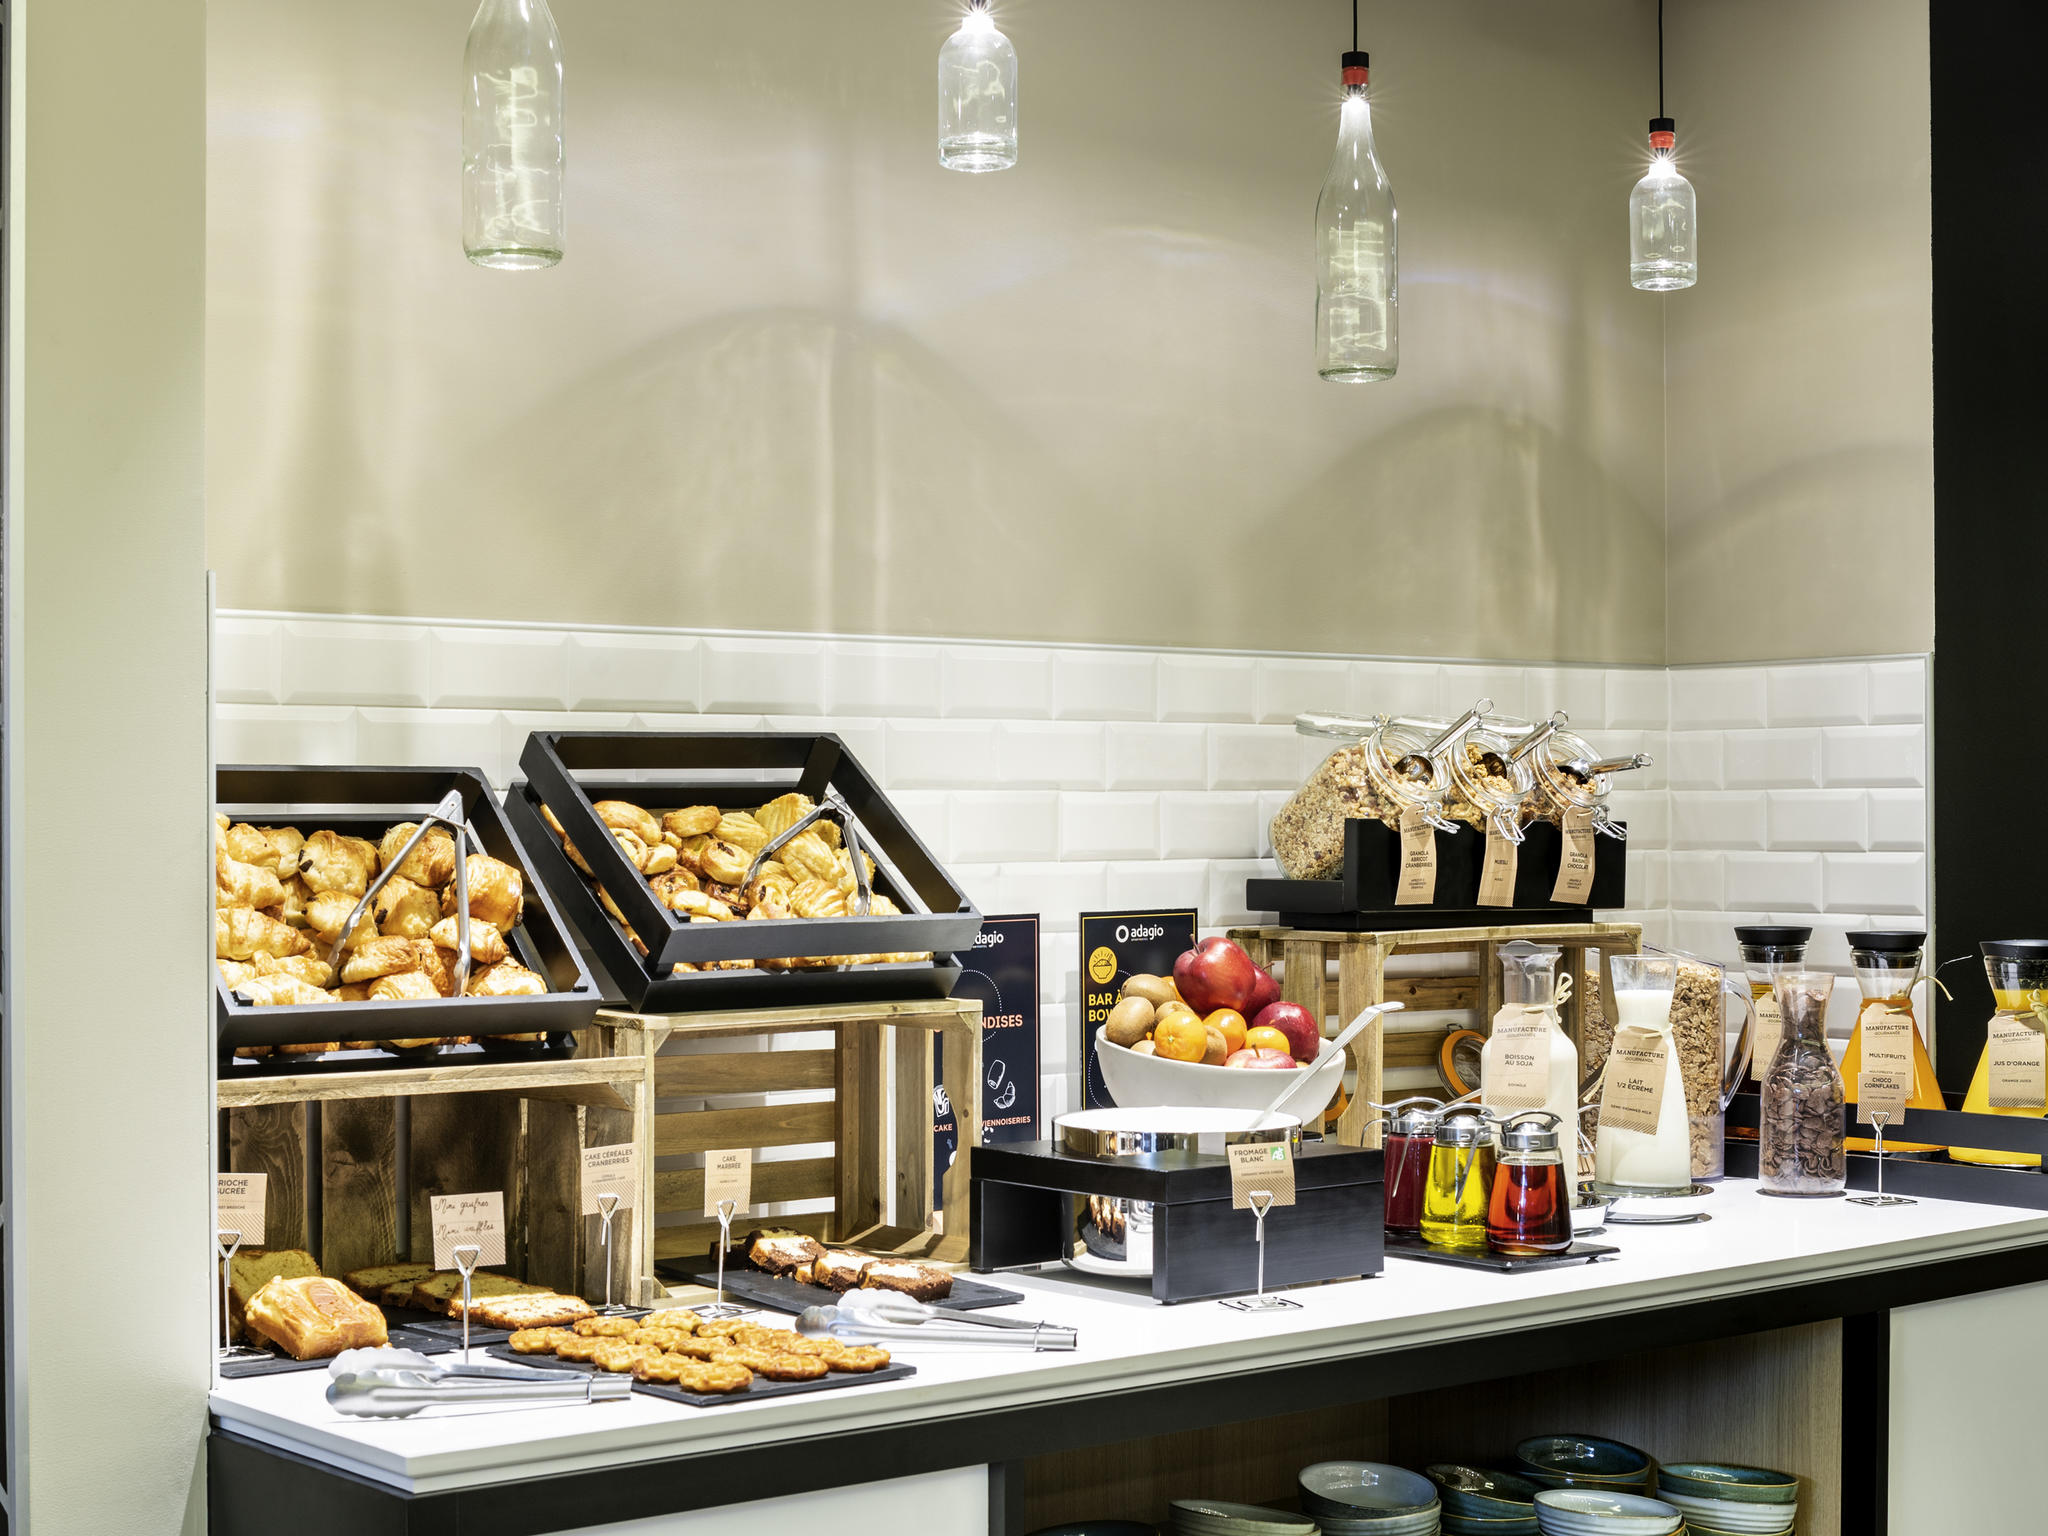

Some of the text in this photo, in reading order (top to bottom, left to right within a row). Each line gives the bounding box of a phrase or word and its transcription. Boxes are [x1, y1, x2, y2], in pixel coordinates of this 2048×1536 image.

[1130, 924, 1164, 941] adagio
[973, 930, 1004, 948] dagio
[1088, 992, 1112, 1007] BAR
[982, 1014, 1023, 1029] NDISES
[1993, 1031, 2041, 1039] MANUFACTURE
[1616, 1049, 1664, 1059] MANUFACTURE
[981, 1116, 1031, 1127] VIENNOISERIES
[933, 1124, 953, 1133] CAKE
[585, 1153, 601, 1161] CAKE
[1234, 1148, 1268, 1156] FROMAGE
[588, 1157, 630, 1168] CRANBERRIES
